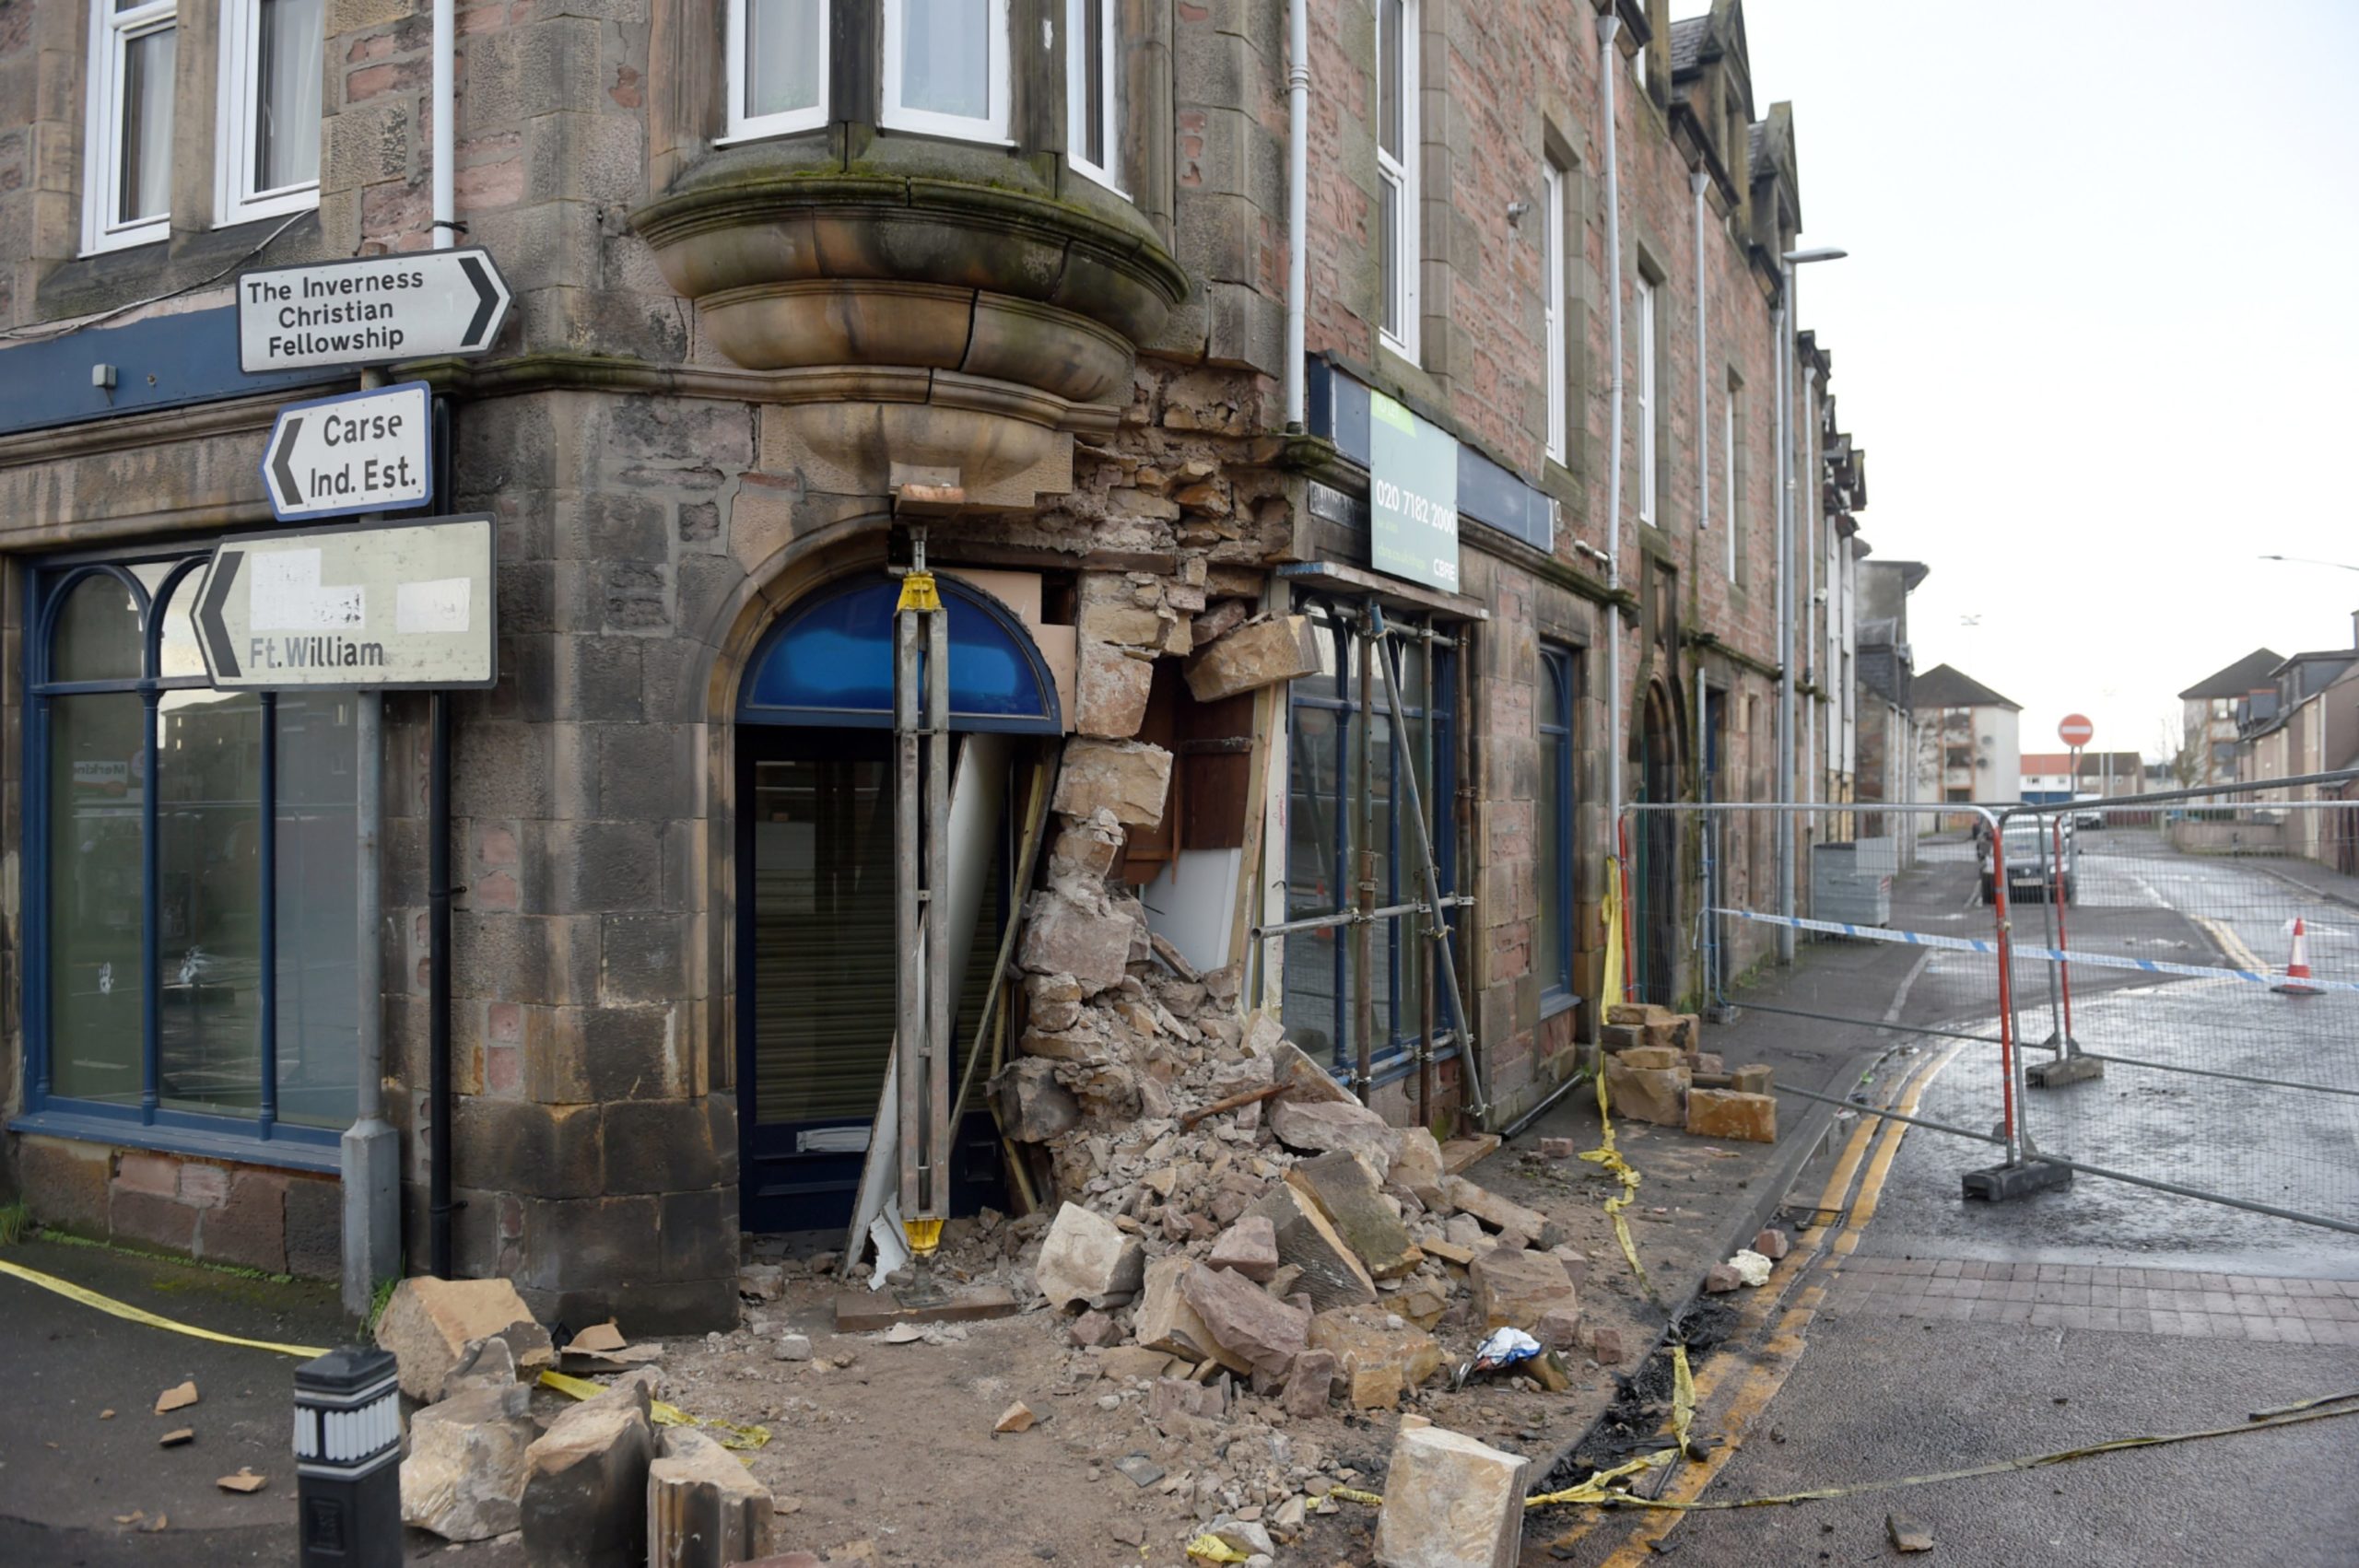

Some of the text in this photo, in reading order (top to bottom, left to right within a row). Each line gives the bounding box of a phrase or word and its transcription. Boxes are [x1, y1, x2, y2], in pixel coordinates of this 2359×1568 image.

[247, 271, 424, 304] The Inverness
[278, 302, 393, 329] Christian
[269, 325, 405, 358] Fellowship
[323, 414, 403, 447] Carse
[311, 456, 417, 497] Ind. Est.
[1377, 479, 1399, 511] 020
[1403, 489, 1428, 523] 7182
[1431, 503, 1455, 535] 2000
